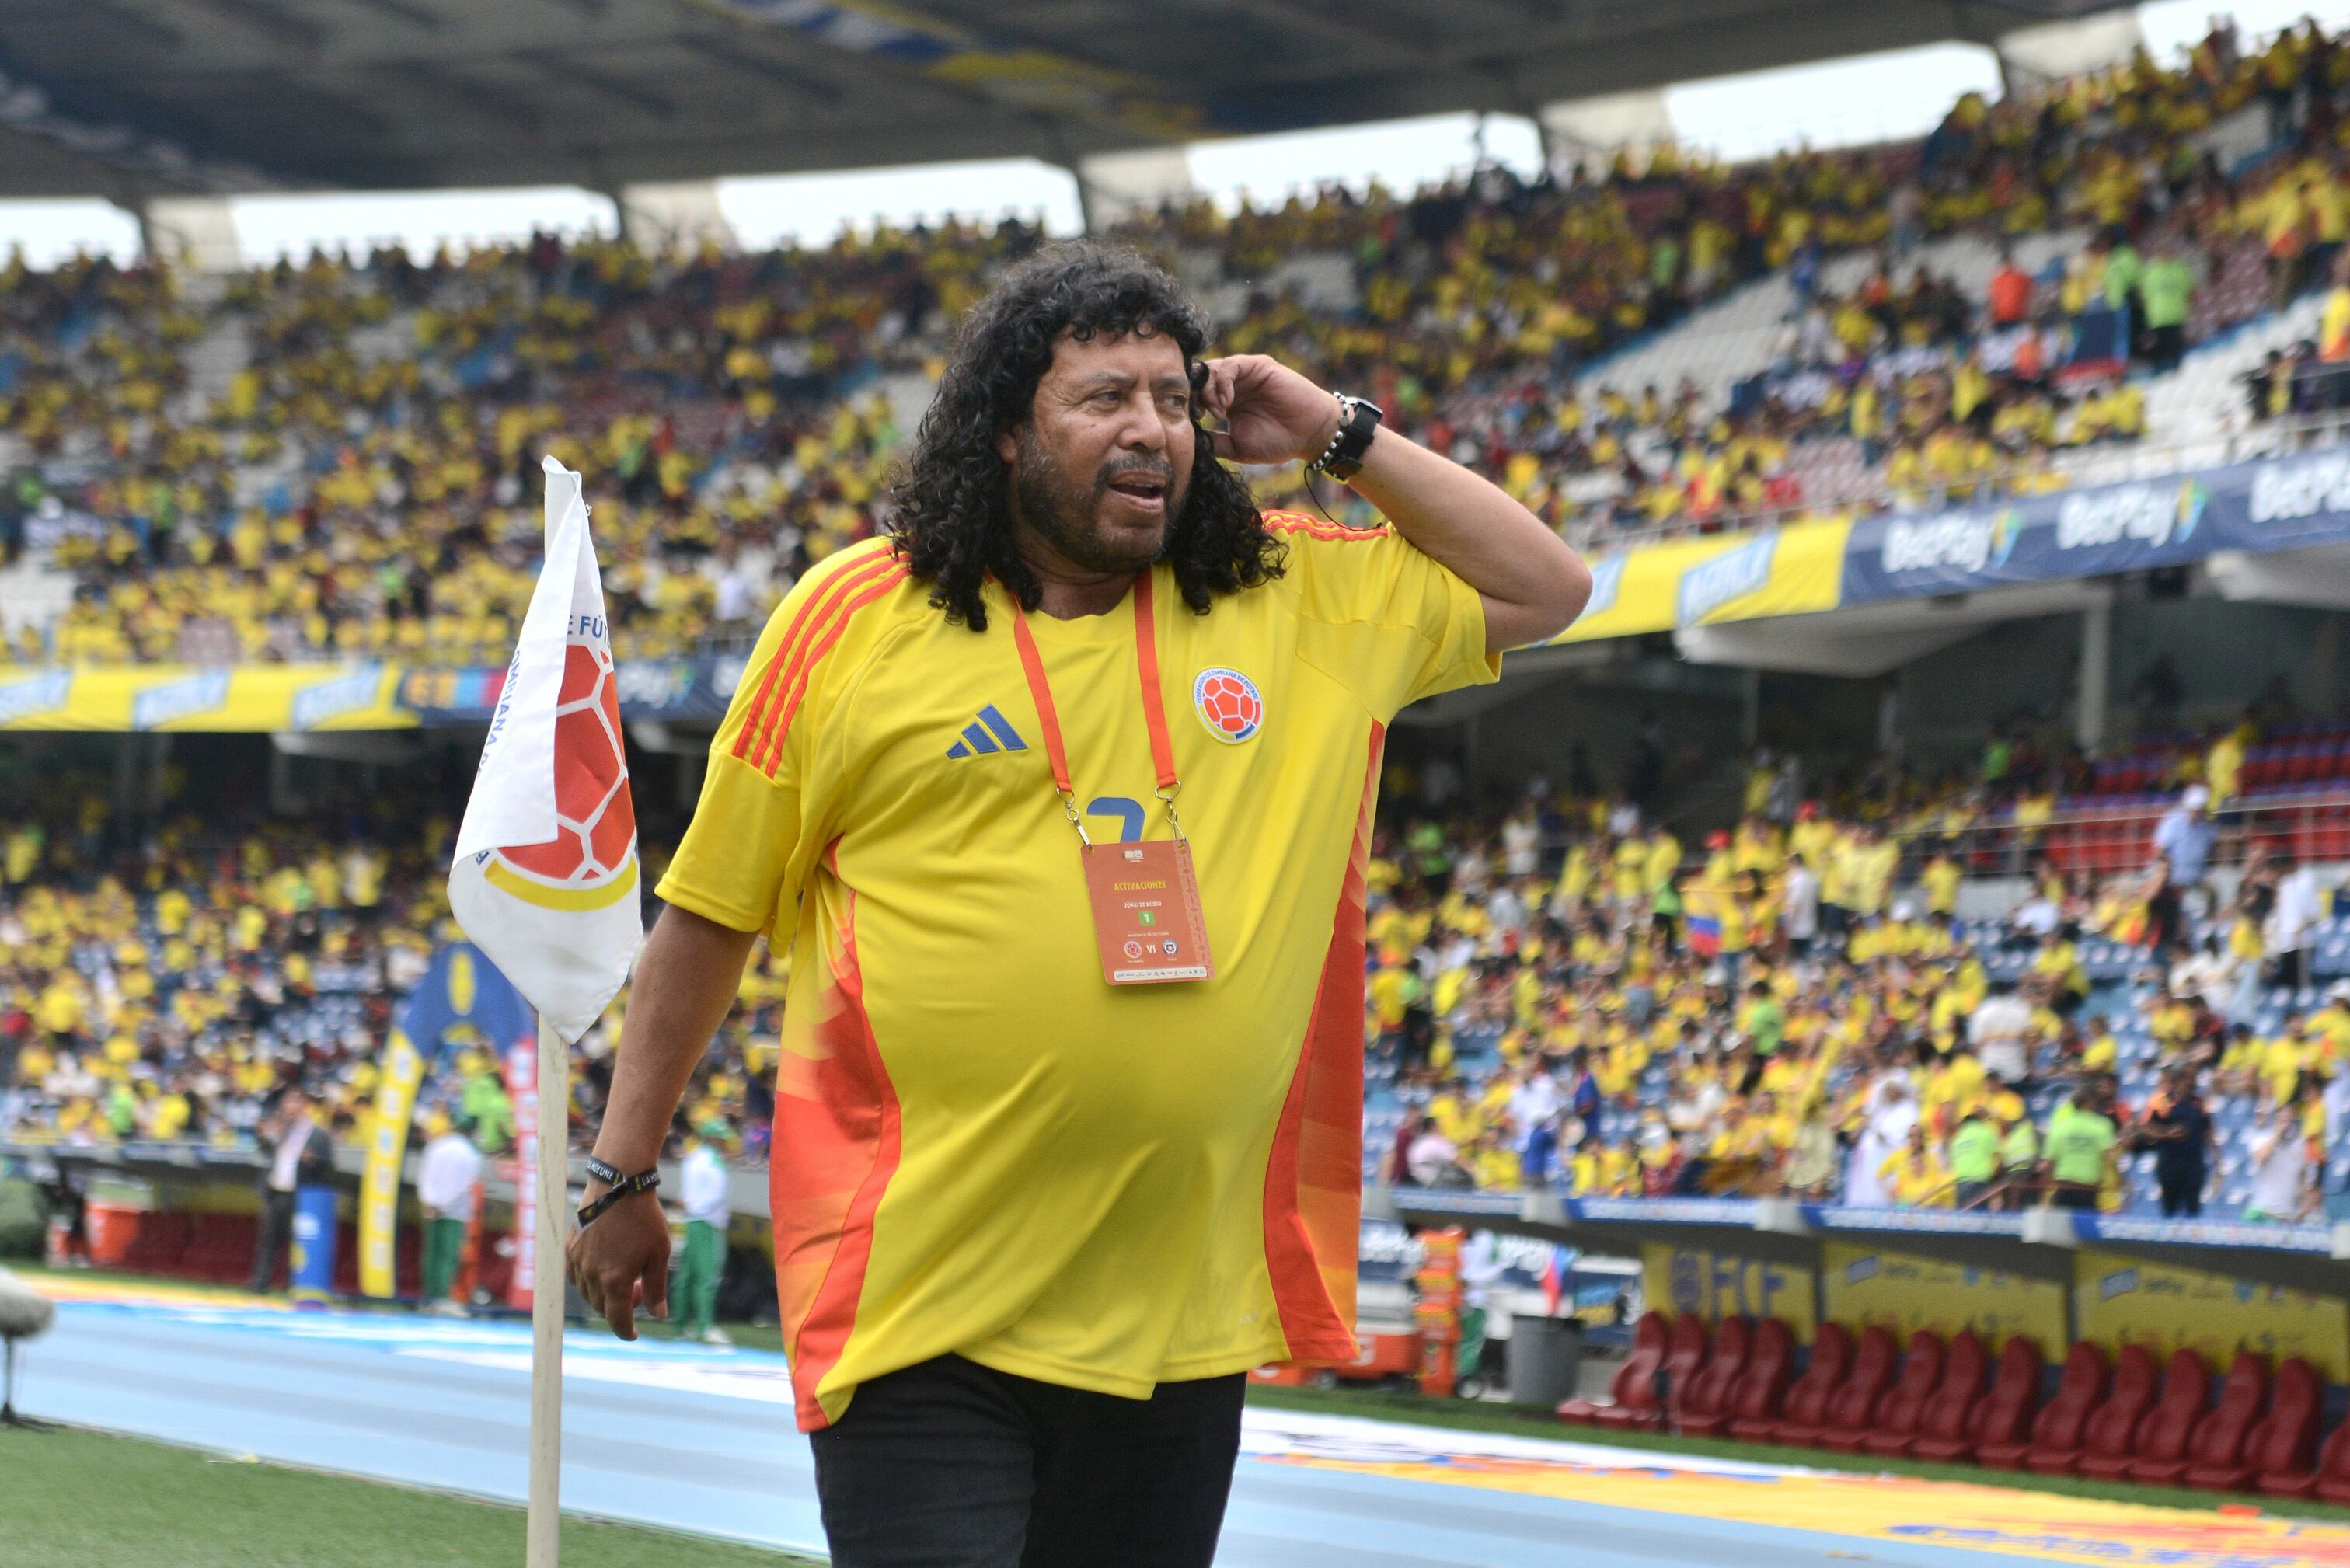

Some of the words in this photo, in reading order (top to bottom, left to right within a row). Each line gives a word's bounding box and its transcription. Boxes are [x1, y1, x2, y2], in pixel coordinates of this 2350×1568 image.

[2249, 450, 2350, 524] BetPla
[1114, 881, 1166, 890] ACTIVACIONES
[1143, 913, 1151, 923] 1
[1146, 944, 1157, 953] VS
[598, 1166, 613, 1180] UNE
